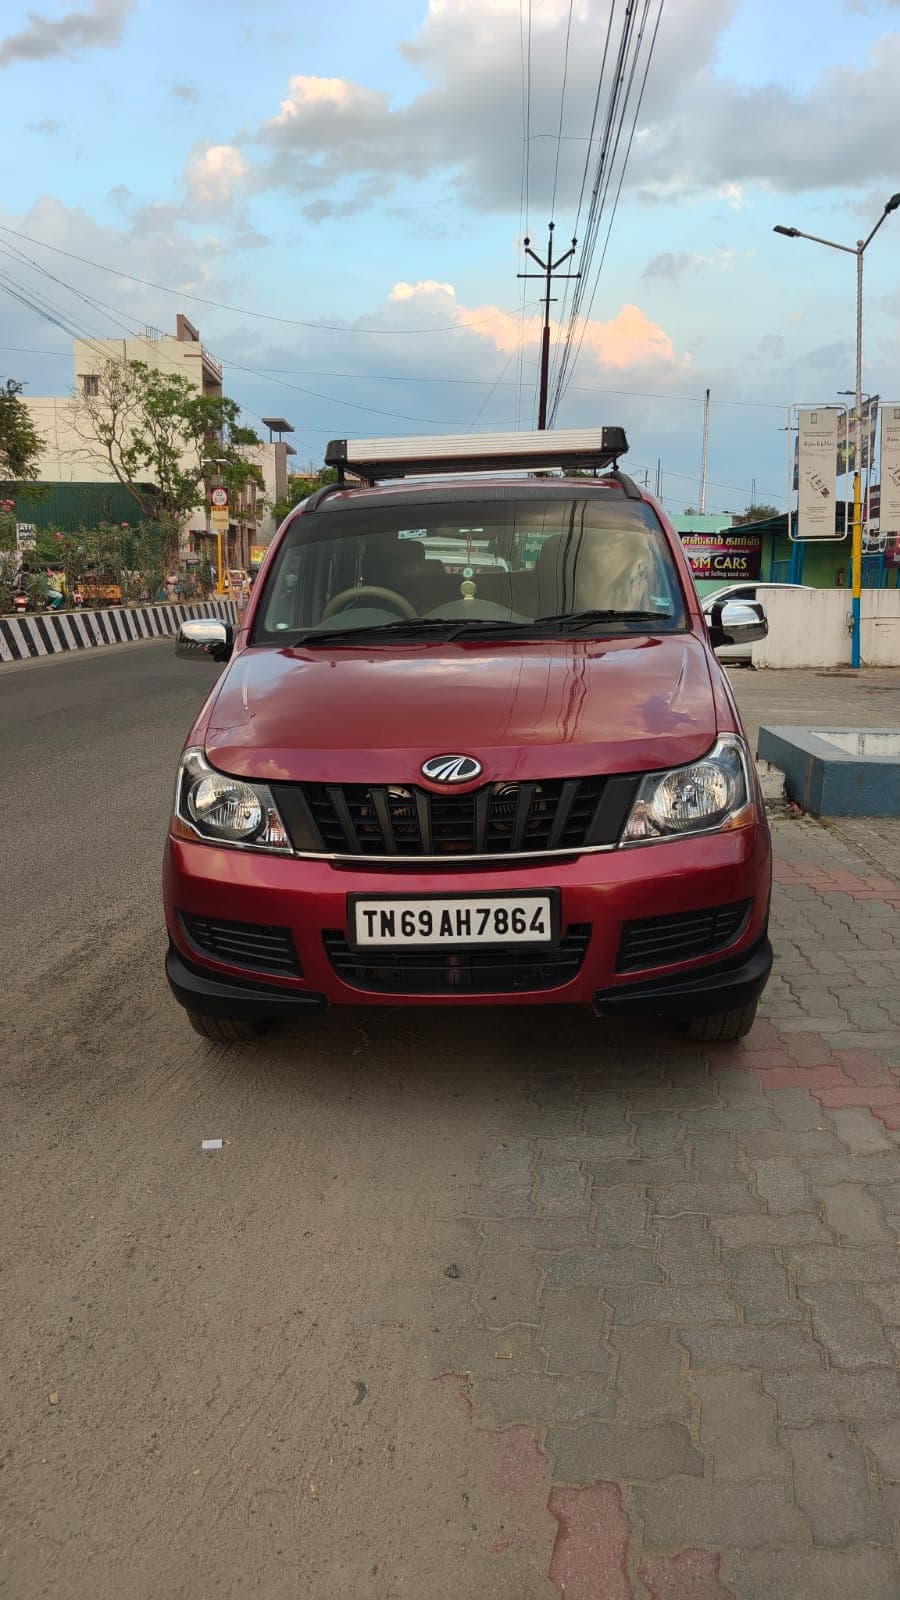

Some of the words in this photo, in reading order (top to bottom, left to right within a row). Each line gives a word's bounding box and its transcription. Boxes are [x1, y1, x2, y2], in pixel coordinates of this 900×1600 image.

[692, 557, 711, 569] SM
[714, 557, 747, 570] CARS
[363, 906, 545, 937] TN69AH7864
